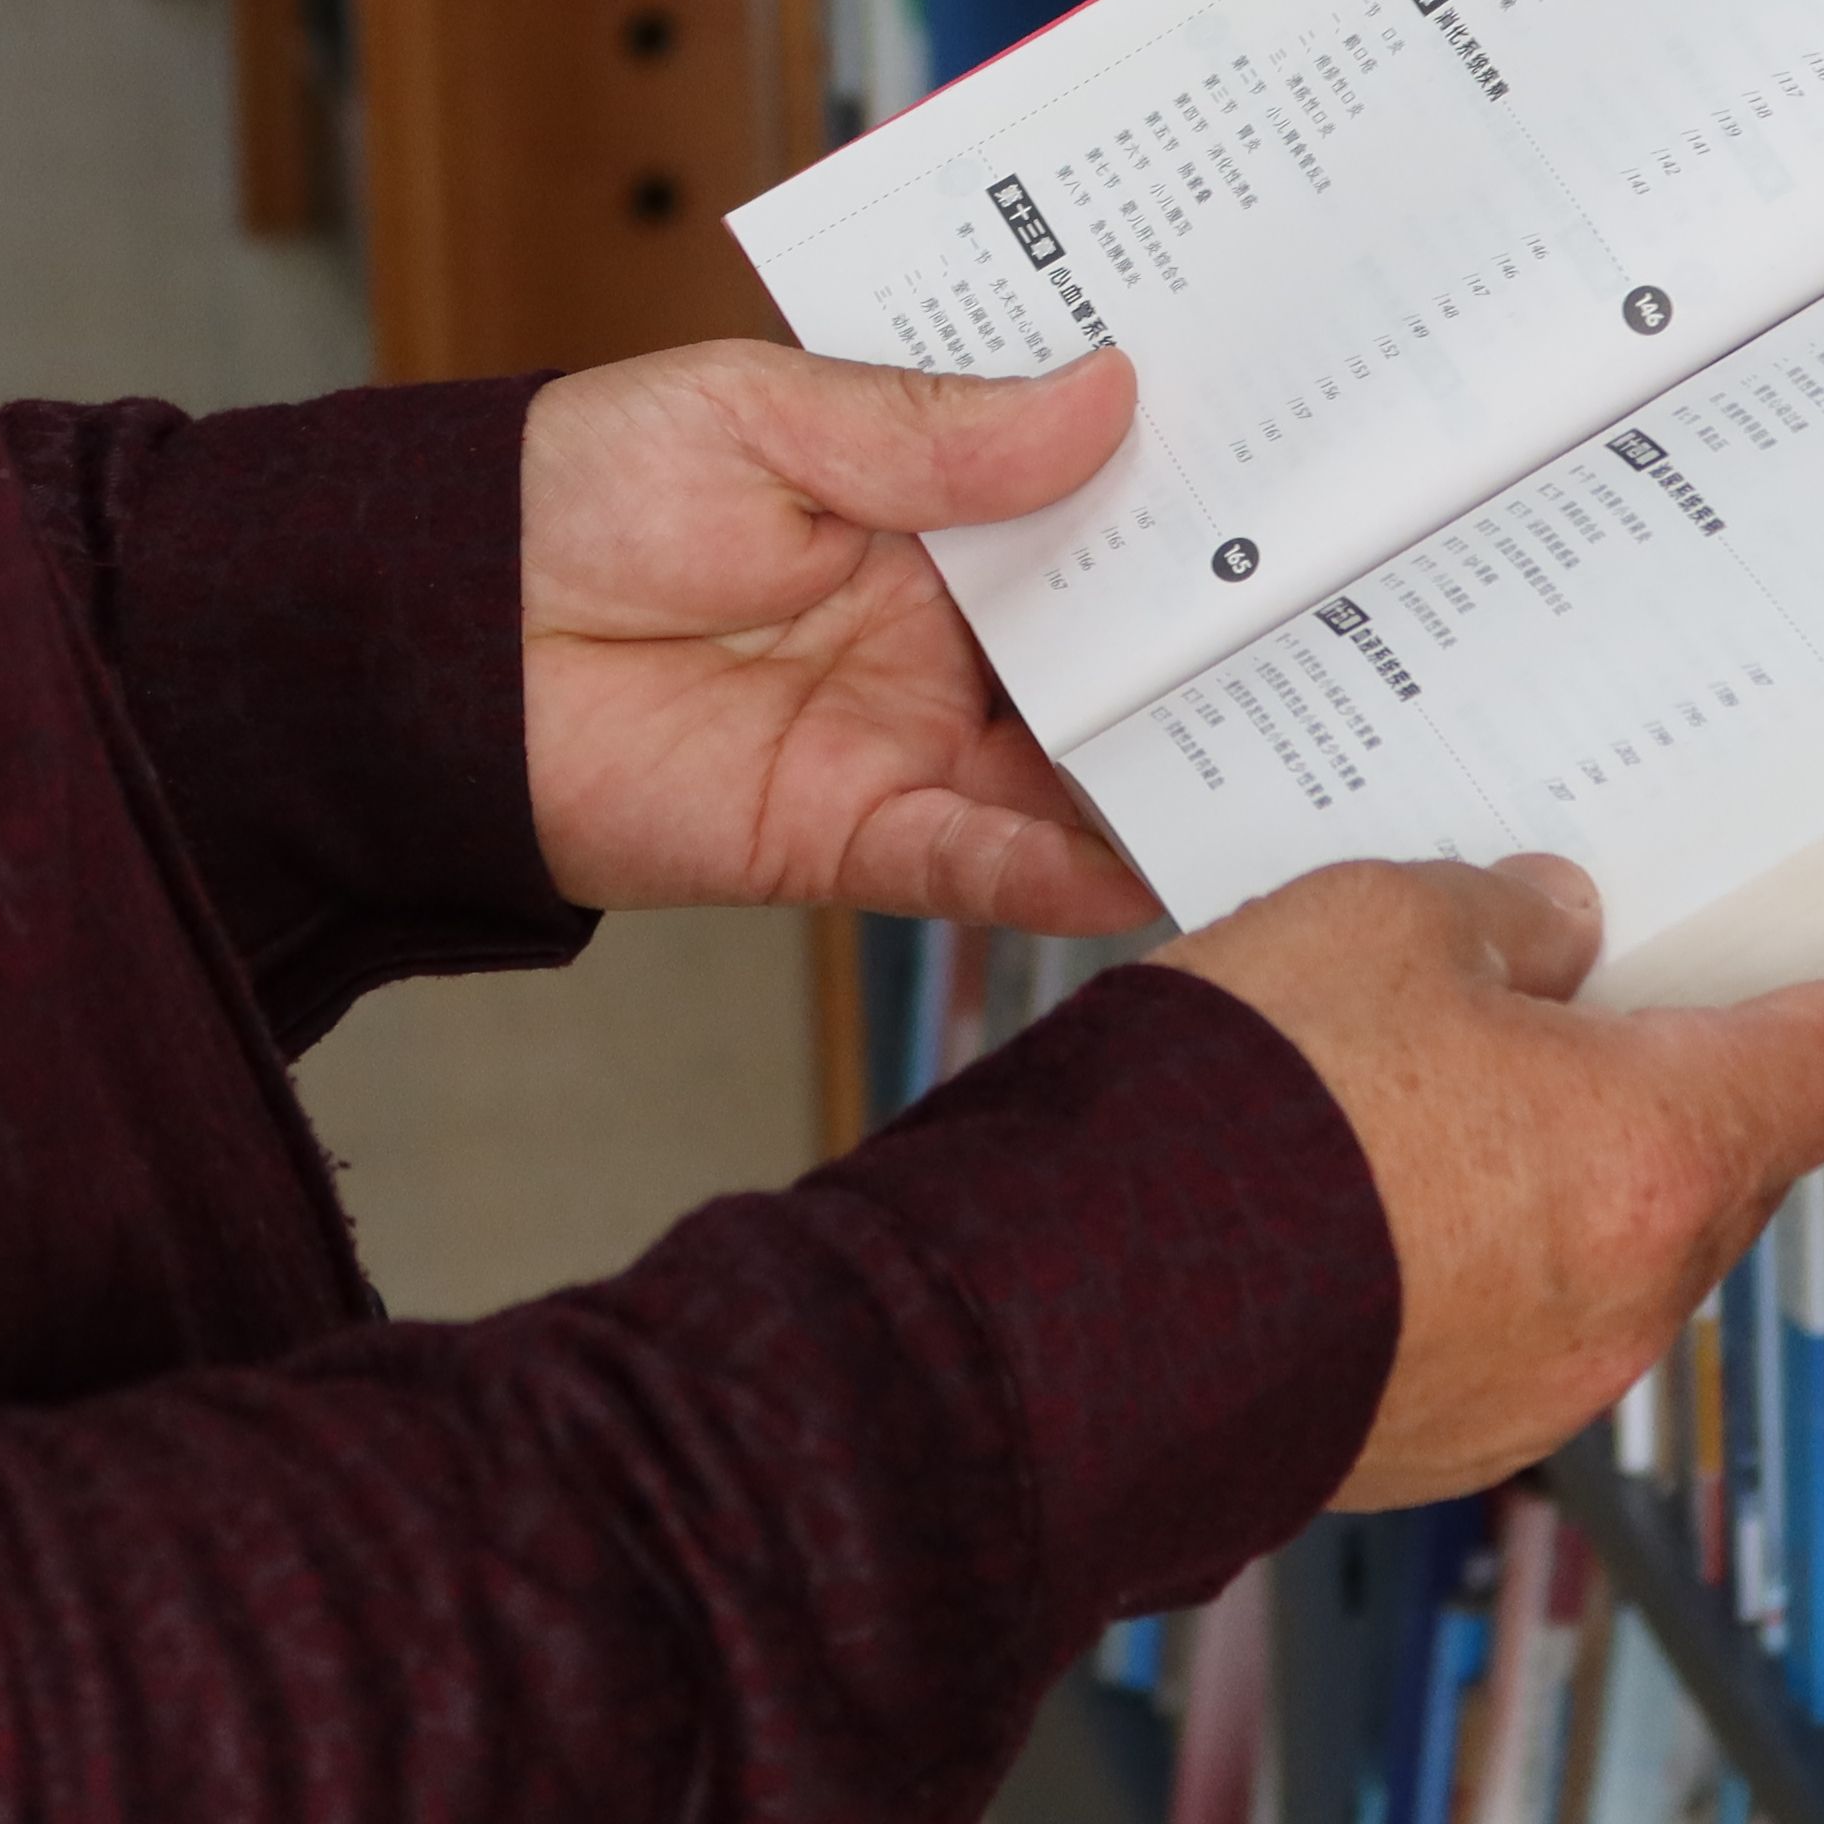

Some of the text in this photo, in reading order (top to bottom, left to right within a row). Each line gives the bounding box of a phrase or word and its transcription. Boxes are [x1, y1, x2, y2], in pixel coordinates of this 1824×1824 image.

[1231, 54, 1430, 339] 第二节 小儿胃食管反流 /149
[1380, 26, 1406, 57] 口炎
[1521, 233, 1548, 260] /146
[1433, 7, 1509, 103] 消化系统疾病
[1628, 289, 1669, 331] 146
[1620, 167, 1651, 195] /143
[1650, 148, 1682, 176] /142
[1681, 128, 1711, 156] /141
[1711, 109, 1743, 137] /139
[1741, 90, 1773, 119] /138
[1771, 71, 1805, 97] /137
[1055, 164, 1254, 464] 第八节 急性胰腺炎 /163
[1084, 147, 1283, 442] 第七节 婴儿肝炎综合征 /161
[1114, 128, 1313, 420] 第六节 小儿腹泻 /157
[1144, 110, 1341, 401] 第五节 肠套叠 /156
[1173, 92, 1371, 380] 第四节 消化性溃疡 /153
[1203, 73, 1401, 360] 第三节 胃炎 /152
[1433, 293, 1460, 319] /148
[1462, 272, 1491, 296] /147
[1491, 252, 1519, 280] /146
[903, 268, 1096, 572] 二、房间隔缺损 /166
[933, 251, 1126, 550] 一、室间隔缺损 /165
[956, 222, 1156, 530] 第一节 先天性心脏病 /165
[992, 179, 1059, 265] 第十三章
[1218, 541, 1254, 579] 165
[1039, 566, 1069, 591] /167
[1647, 462, 1725, 537] 泌尿系统疾病
[1349, 627, 1421, 702] 血液系统疾病
